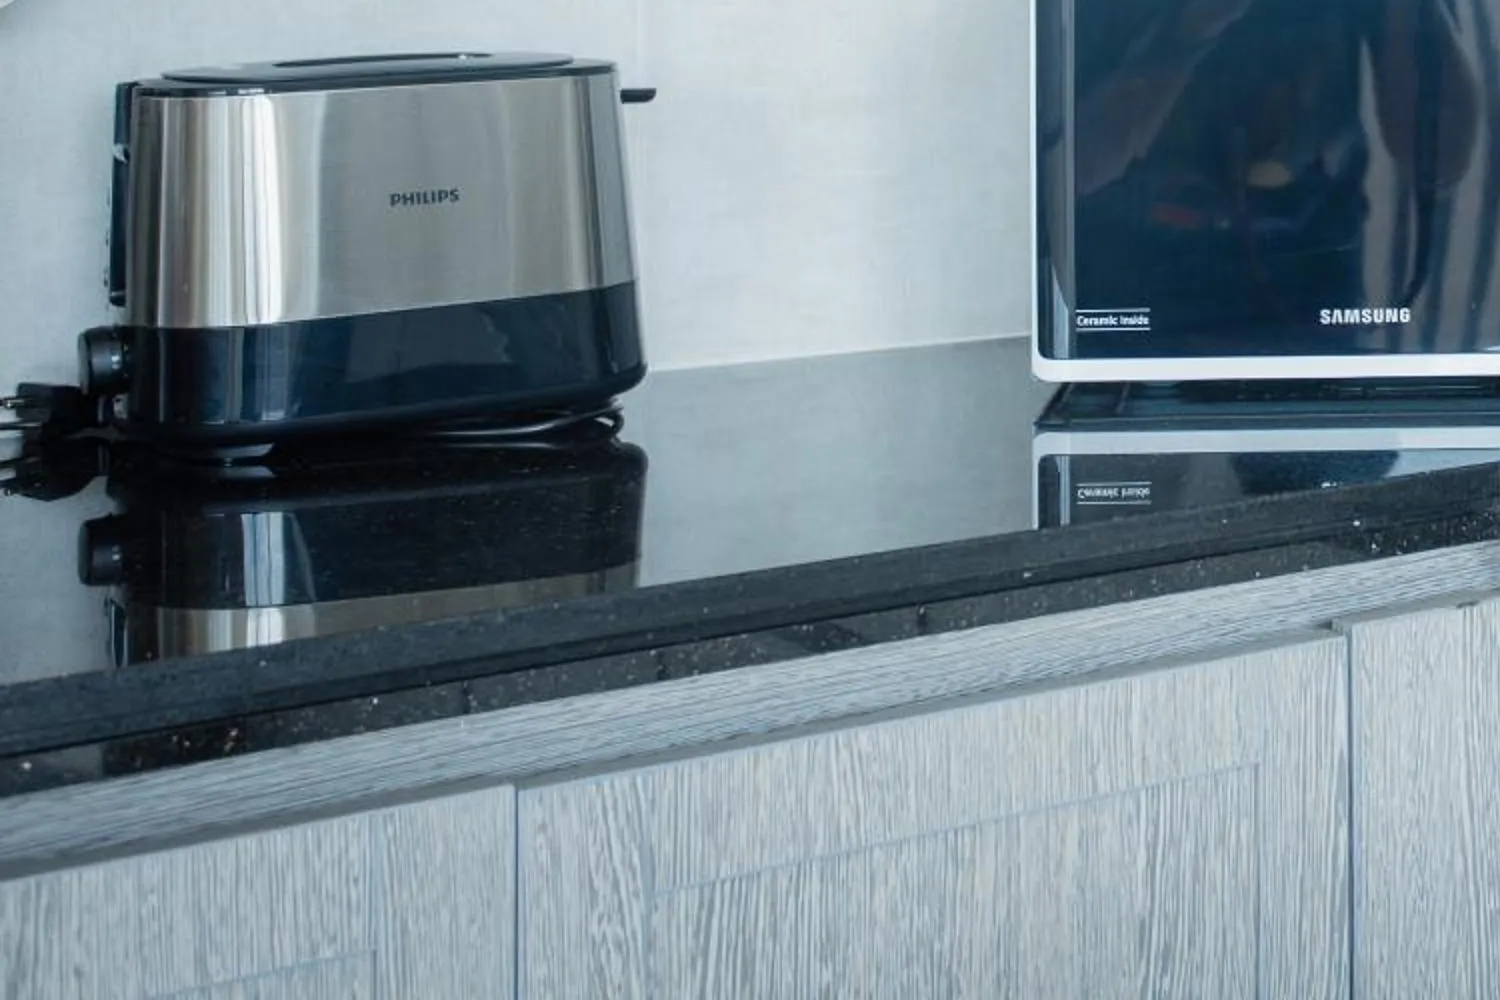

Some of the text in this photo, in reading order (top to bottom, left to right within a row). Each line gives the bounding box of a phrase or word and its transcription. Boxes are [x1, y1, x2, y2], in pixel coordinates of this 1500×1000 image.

[390, 188, 460, 207] PHILIPS
[1077, 315, 1119, 326] Ceramic
[1319, 307, 1411, 325] SAMSUNG
